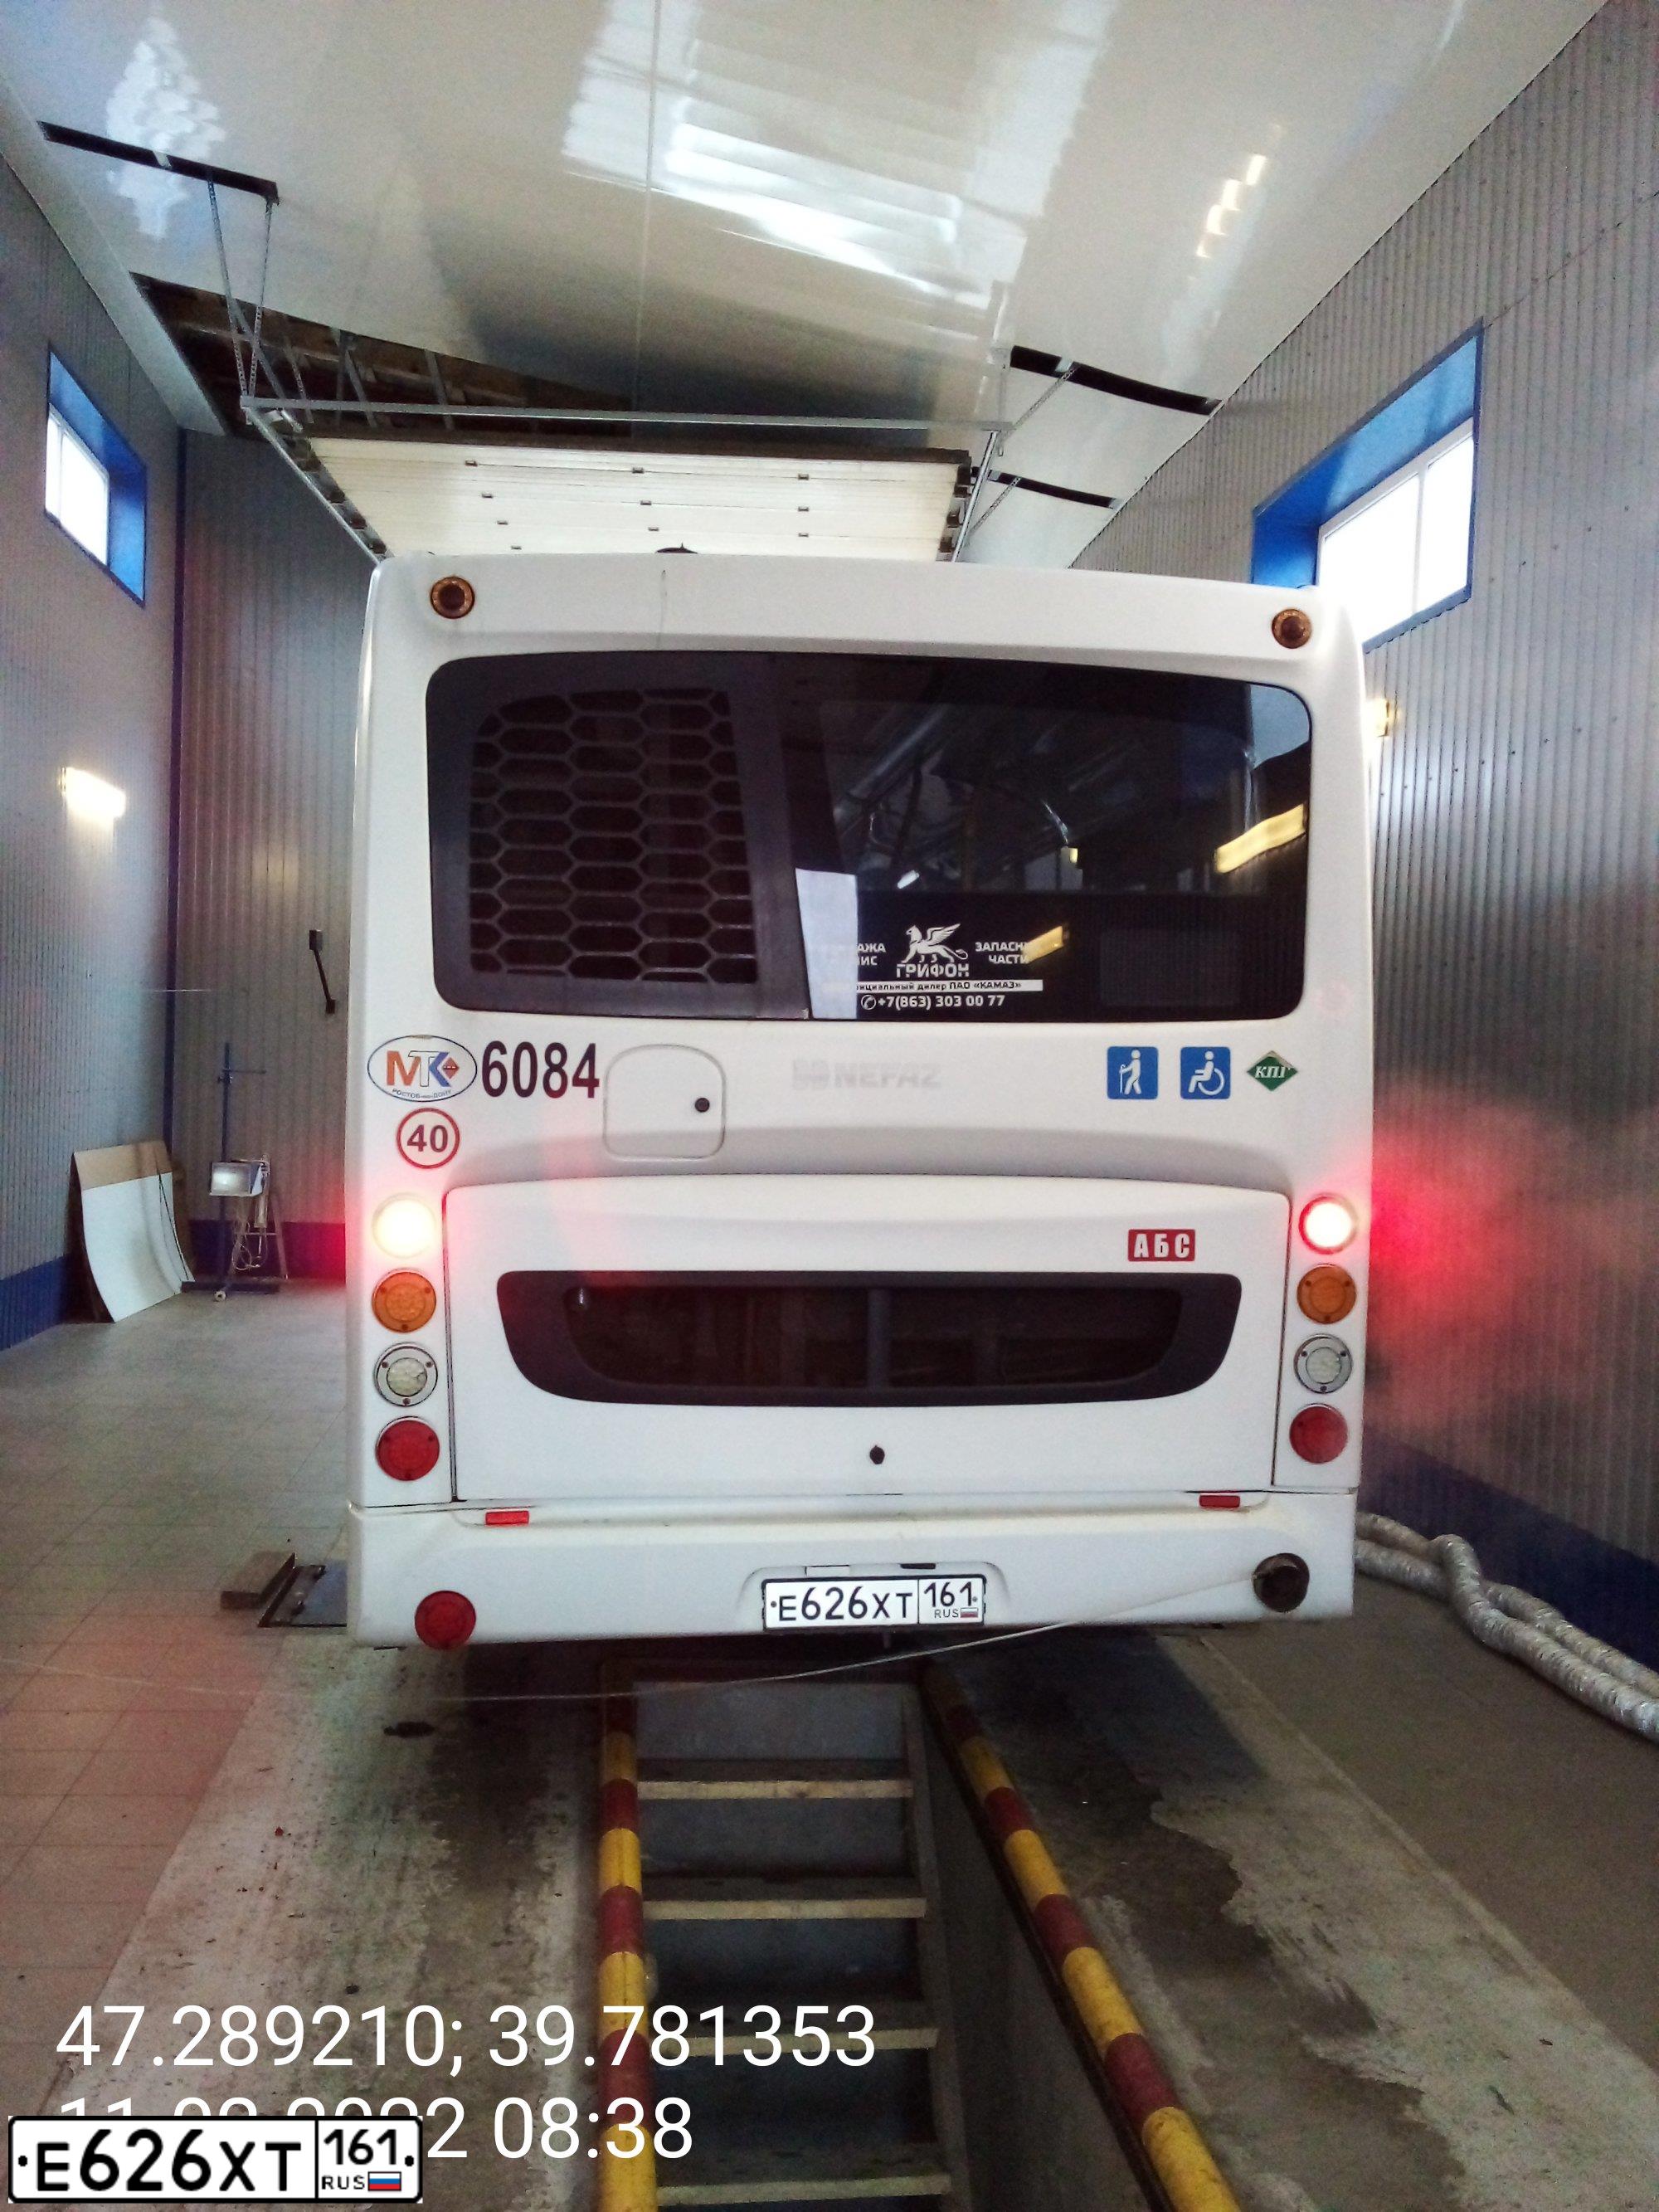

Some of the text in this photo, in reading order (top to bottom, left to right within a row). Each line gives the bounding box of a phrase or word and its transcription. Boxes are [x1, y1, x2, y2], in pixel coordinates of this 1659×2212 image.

[857, 943, 887, 953] АЖА
[896, 962, 970, 978] ГРИФОН
[917, 983, 946, 992] дилер
[950, 982, 971, 990] ПАО
[878, 994, 1005, 1011] +7(863) 303 00 77
[481, 1040, 600, 1099] 6084
[834, 1062, 942, 1089] NEFAZ
[406, 1124, 449, 1152] 40
[1133, 1233, 1190, 1258] АБС
[923, 1581, 972, 1607] 161
[934, 1608, 959, 1619] RUS
